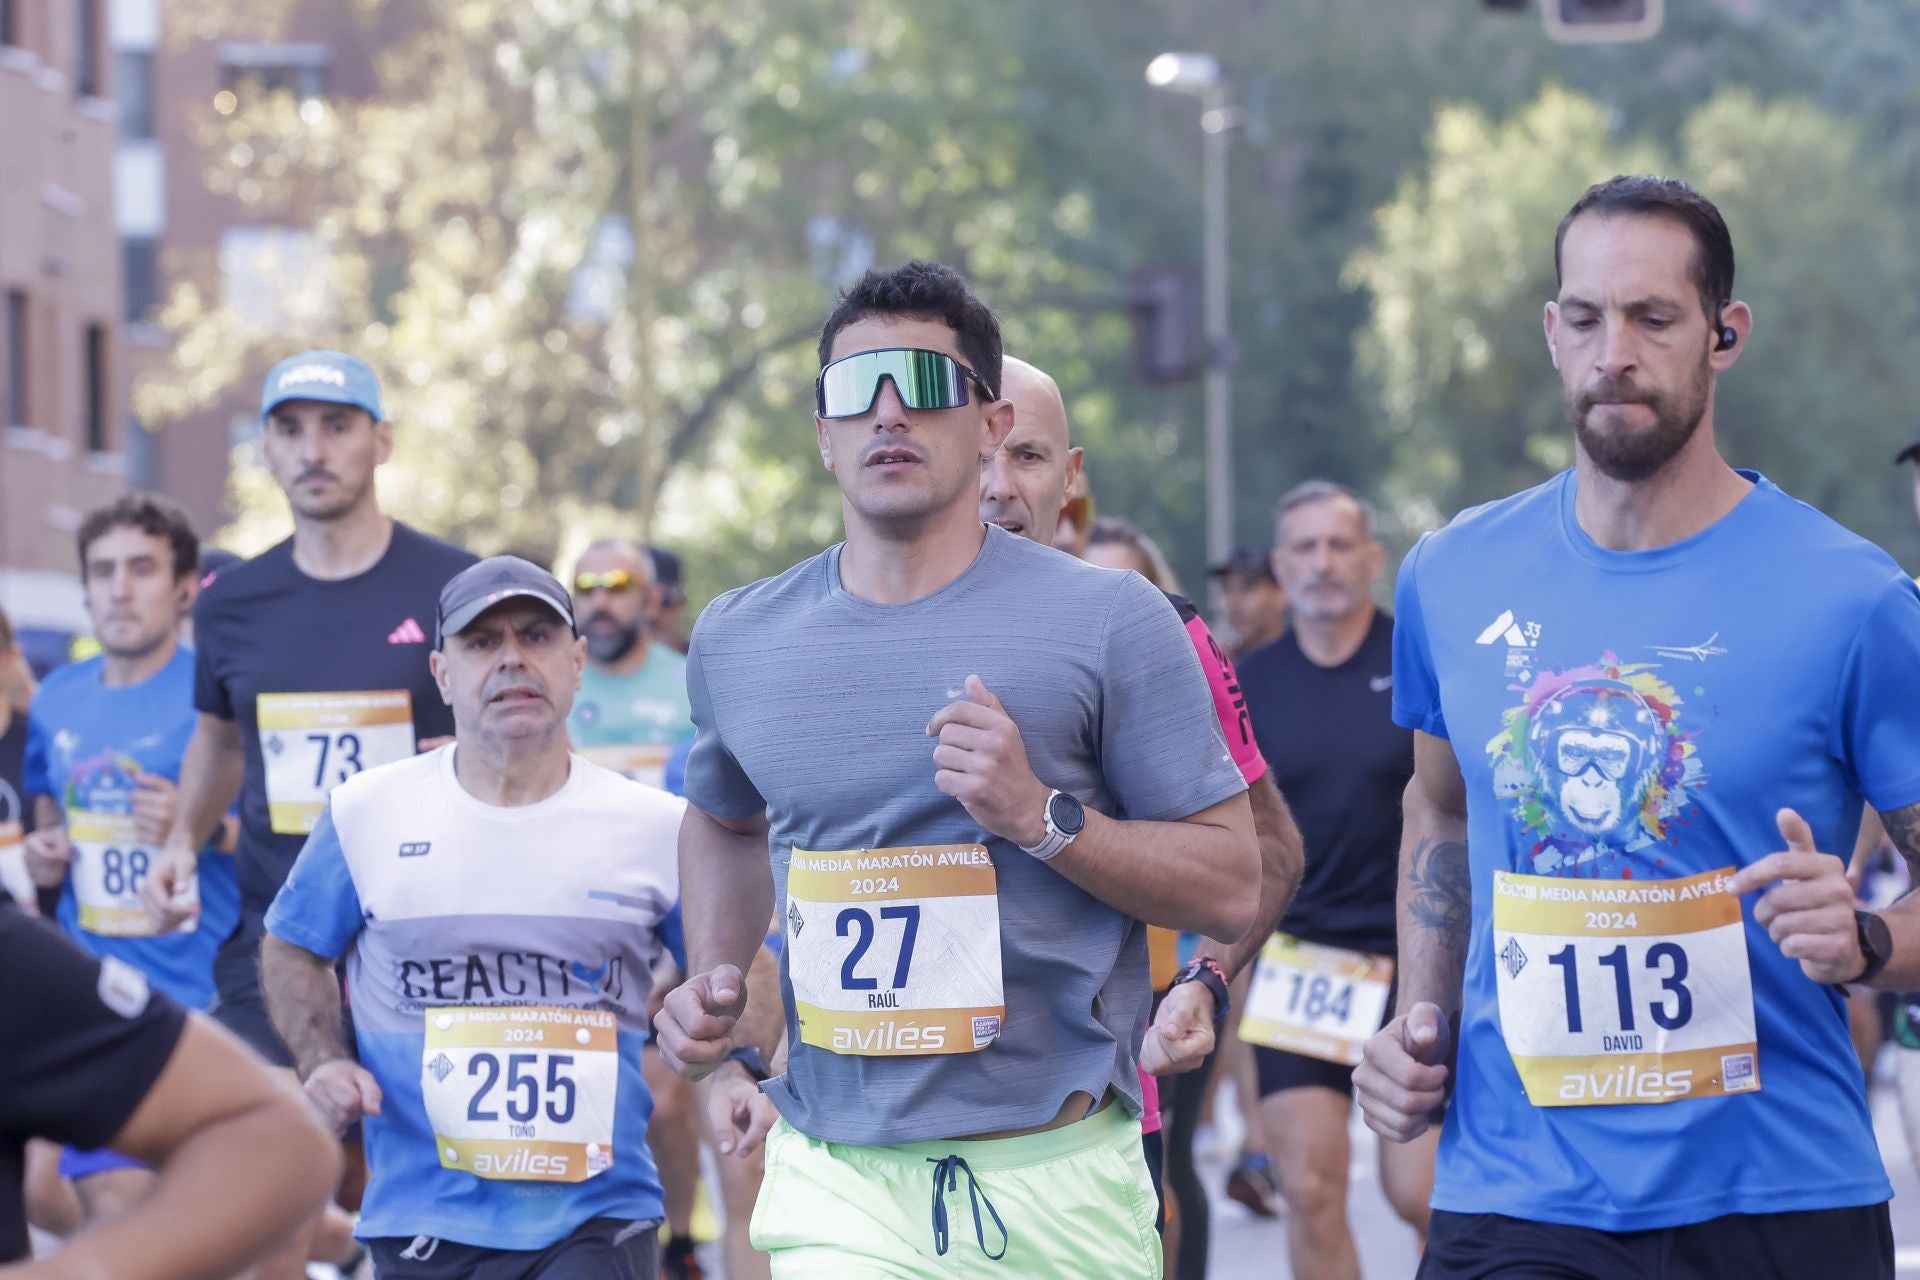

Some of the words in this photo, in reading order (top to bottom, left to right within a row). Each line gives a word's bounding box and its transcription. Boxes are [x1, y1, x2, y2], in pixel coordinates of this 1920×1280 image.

[307, 734, 363, 787] 73
[104, 848, 149, 895] 88
[809, 859, 853, 872] MEDIA
[857, 851, 934, 870] MARATÓN
[937, 849, 988, 866] AVILÉS
[850, 876, 900, 894] 2024
[1541, 886, 1587, 903] MEDIA
[1591, 886, 1676, 904] MARATÓN
[1585, 911, 1638, 929] 2024
[835, 905, 921, 990] 27
[868, 990, 900, 1008] RAÚL
[1287, 972, 1355, 1022] 184
[1548, 942, 1692, 1032] 113
[468, 1011, 507, 1023] MEDIA
[510, 1010, 572, 1024] MARATÓN
[573, 1013, 612, 1028] AVILÉS
[504, 1029, 544, 1042] 2024
[832, 1021, 946, 1050] avilés
[1603, 1035, 1643, 1051] DAVID
[467, 1053, 576, 1123] 255
[1559, 1064, 1693, 1099] avilés
[509, 1122, 535, 1138] TOÑO
[473, 1148, 569, 1175] avilés
